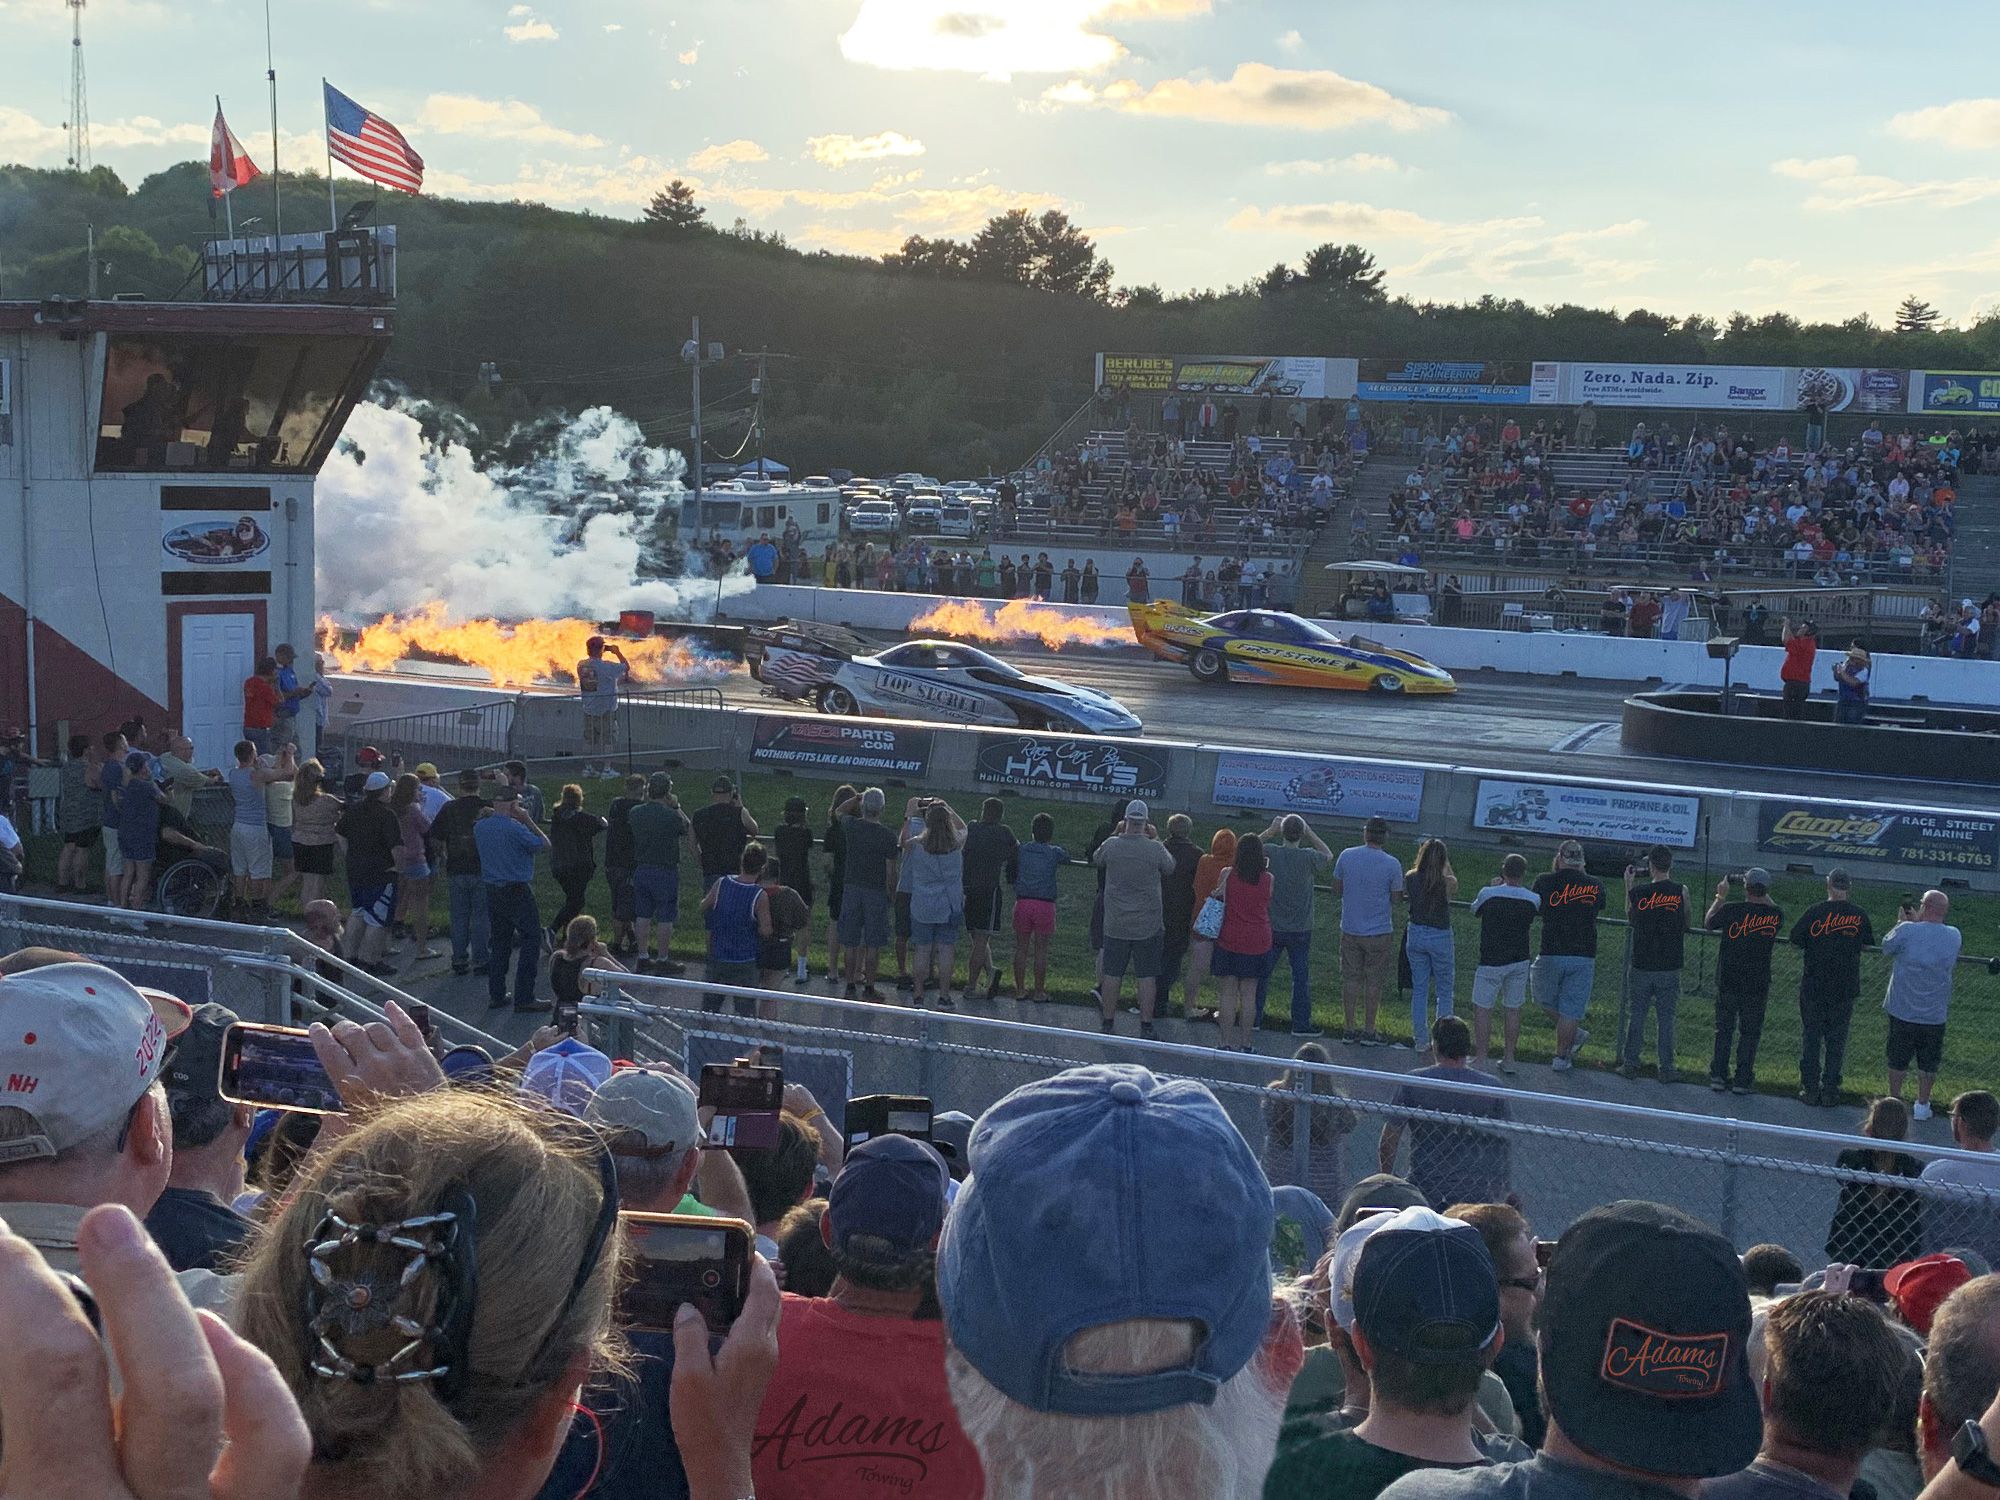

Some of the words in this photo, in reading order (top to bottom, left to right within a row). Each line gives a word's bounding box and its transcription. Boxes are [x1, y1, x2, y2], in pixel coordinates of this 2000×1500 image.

[1105, 358, 1173, 369] BERUBE'S
[1403, 362, 1444, 373] SISSON
[1411, 370, 1480, 380] ENGINEERING
[1583, 370, 1626, 383] Zero.
[1630, 371, 1681, 385] Nada.
[1686, 372, 1718, 388] Zip.
[1367, 385, 1420, 393] AEROSPACE
[1429, 386, 1470, 394] DEFENSE
[1479, 387, 1520, 395] MEDICAL
[1624, 386, 1664, 394] worldwide.
[1729, 385, 1766, 397] Bangor
[880, 673, 912, 692] TOP
[917, 684, 979, 713] SECRET
[860, 740, 894, 751] .COM
[1018, 737, 1052, 761] Race
[1055, 741, 1093, 765] Cars
[754, 748, 799, 760] NOTHING
[796, 752, 817, 762] FITS
[816, 753, 837, 764] LIKE
[837, 755, 852, 765] AN
[852, 757, 895, 769] ORIGINAL
[896, 761, 922, 771] PART
[1005, 756, 1139, 786] HALL'S
[979, 773, 1071, 789] HallsCustom.com
[1560, 794, 1608, 806] EASTERN
[1611, 799, 1661, 812] PROPANE
[1662, 802, 1671, 812] &
[1672, 803, 1690, 815] OIL
[1558, 817, 1595, 828] Propane
[1598, 820, 1620, 829] Fuel
[1619, 822, 1639, 831] Oil
[1653, 826, 1689, 836] Service
[1773, 810, 1882, 838] Camco
[1902, 816, 1936, 827] RACE
[1946, 820, 1996, 831] STREET
[1631, 833, 1683, 844] eastern.com
[1922, 828, 1974, 840] MARINE
[1823, 843, 1889, 857] ENGINES
[1901, 848, 1993, 866] 781-331-6763
[1549, 883, 1600, 907] Adams
[1638, 892, 1681, 911] Adams
[1728, 913, 1780, 939] Adams
[1810, 912, 1863, 937] Adams
[7, 1073, 39, 1094] NH
[1607, 1335, 1719, 1377] Adams
[1676, 1374, 1704, 1390] Towing
[751, 1393, 950, 1472] Adams
[856, 1465, 914, 1496] Towing
